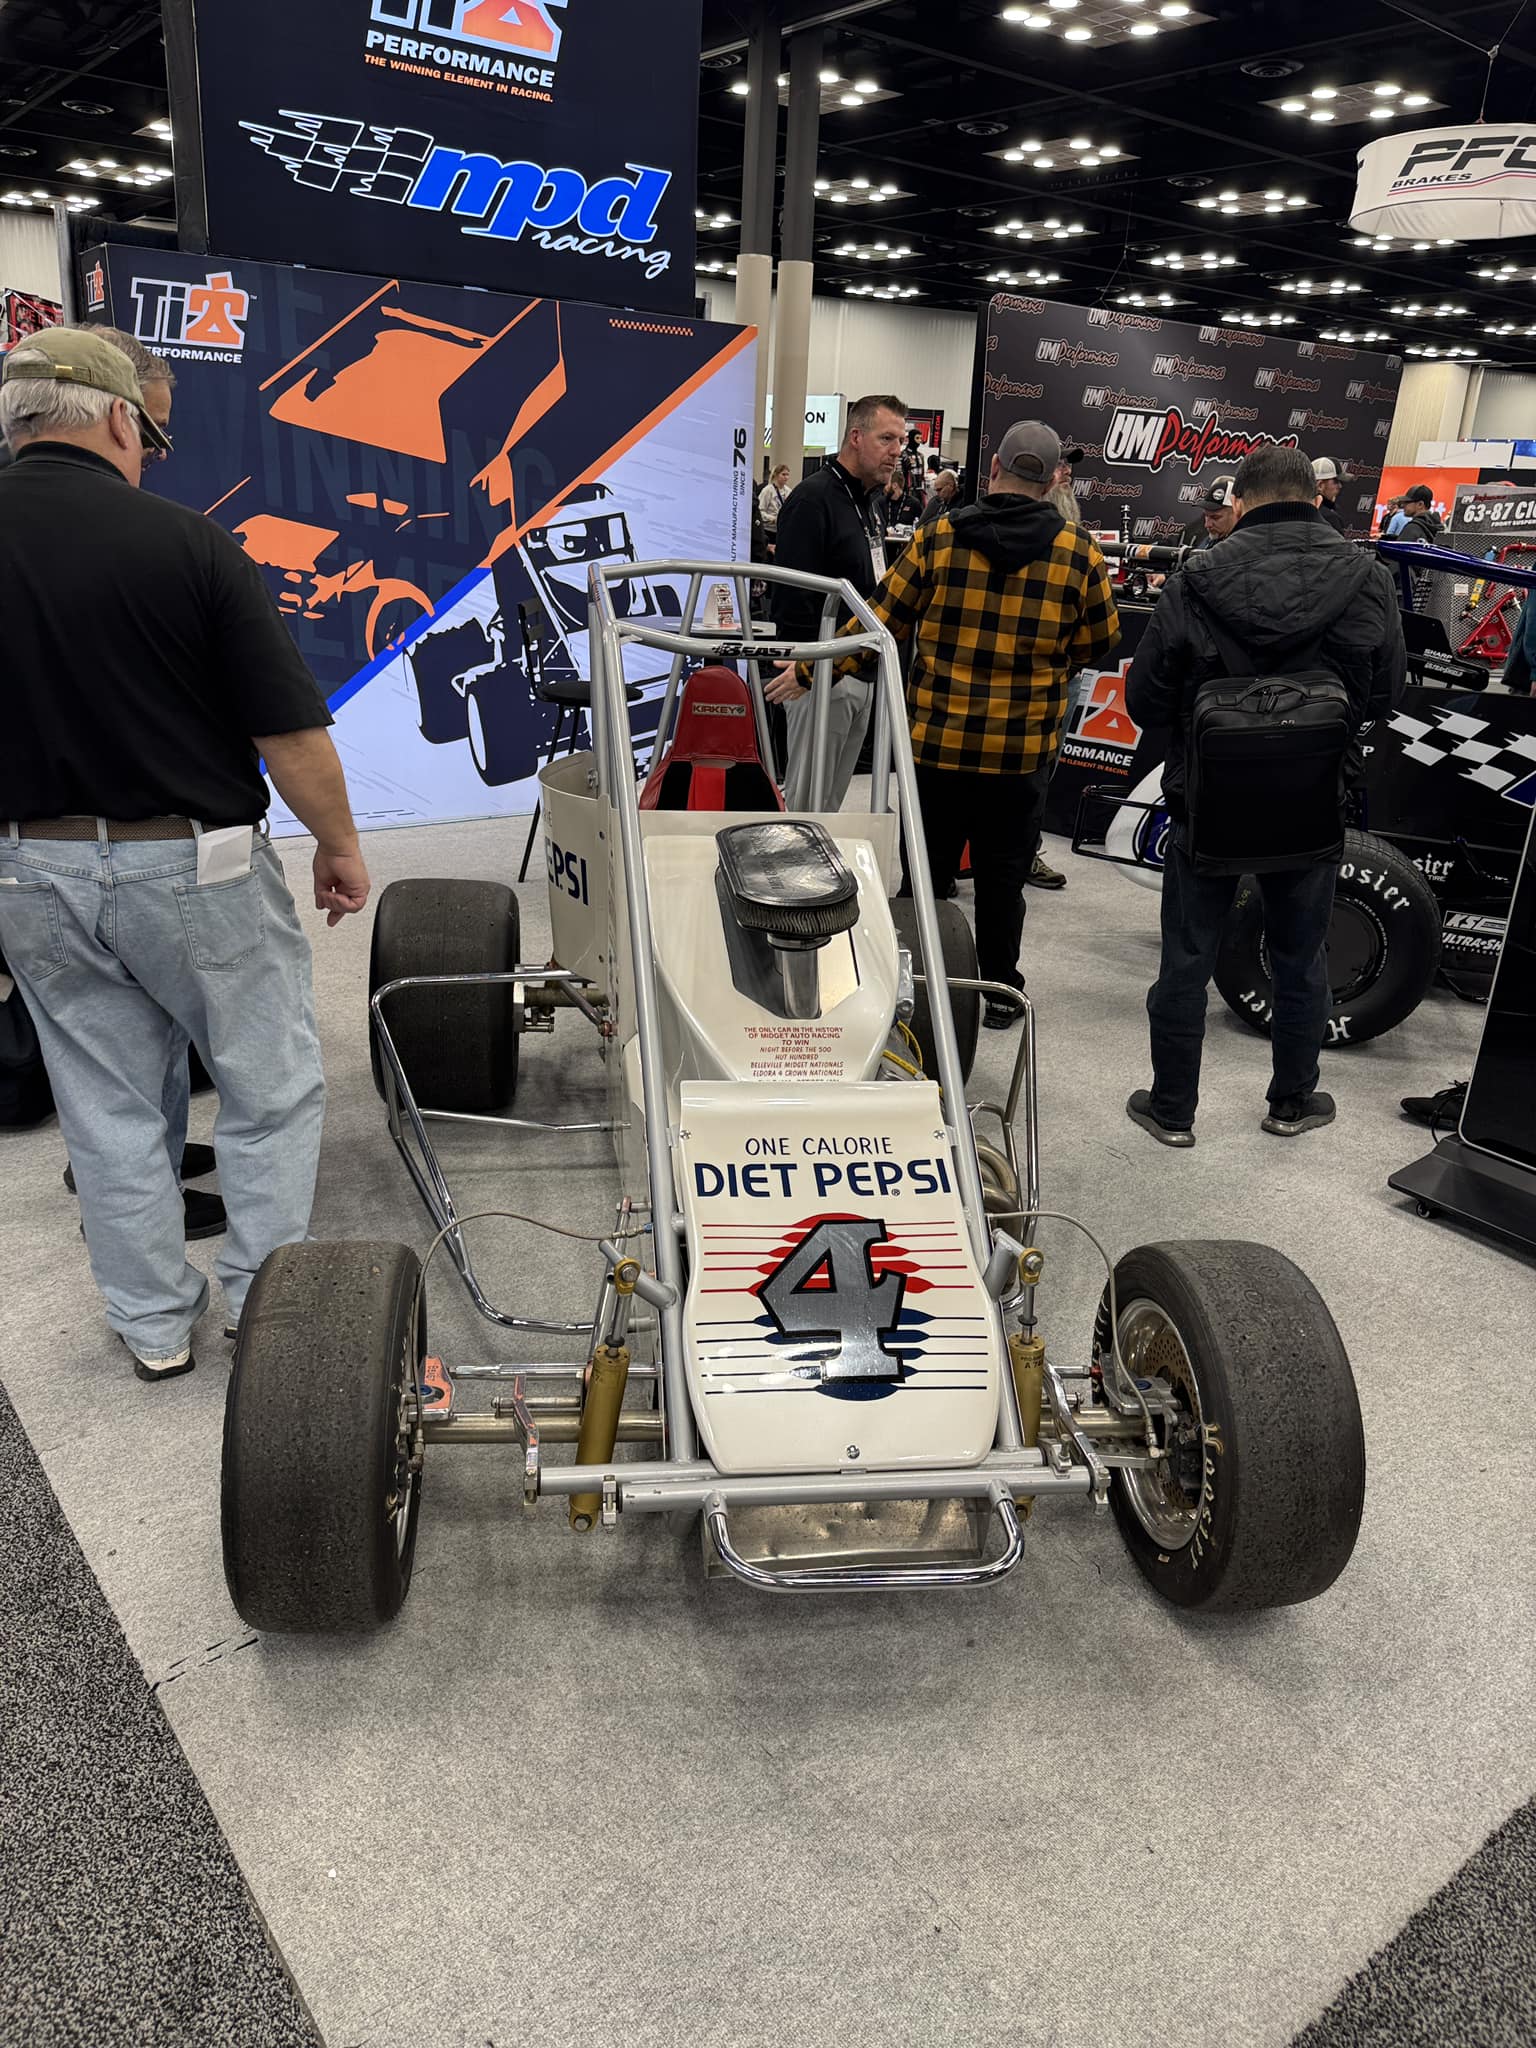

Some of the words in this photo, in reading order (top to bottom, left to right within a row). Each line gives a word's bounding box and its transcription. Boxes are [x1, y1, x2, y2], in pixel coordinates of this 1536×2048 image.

[365, 30, 555, 88] PERFORMANCE
[364, 54, 387, 67] THE
[389, 59, 441, 79] WINNING
[443, 72, 494, 90] ELEMENT
[495, 83, 508, 93] IN
[510, 86, 553, 103] RACING.
[407, 145, 672, 243] mpd
[1391, 172, 1472, 189] BRAKES
[532, 230, 671, 279] racing
[143, 346, 243, 364] ERFORMANCE
[1037, 341, 1059, 360] UMI
[1153, 357, 1174, 376] UMI
[733, 428, 747, 468] 76
[1107, 413, 1167, 460] UMI
[731, 470, 740, 541] MANUFACTURING
[1463, 502, 1515, 523] 63-87
[692, 704, 736, 713] KIRKEY
[1062, 744, 1134, 767] ORMANCE
[810, 1069, 844, 1077] NATIONALS
[744, 1137, 790, 1156] ONE
[801, 1136, 893, 1156] CALORIE
[694, 1162, 798, 1197] DIET
[813, 1158, 951, 1197] PEPSI
[756, 1218, 908, 1385] 4
